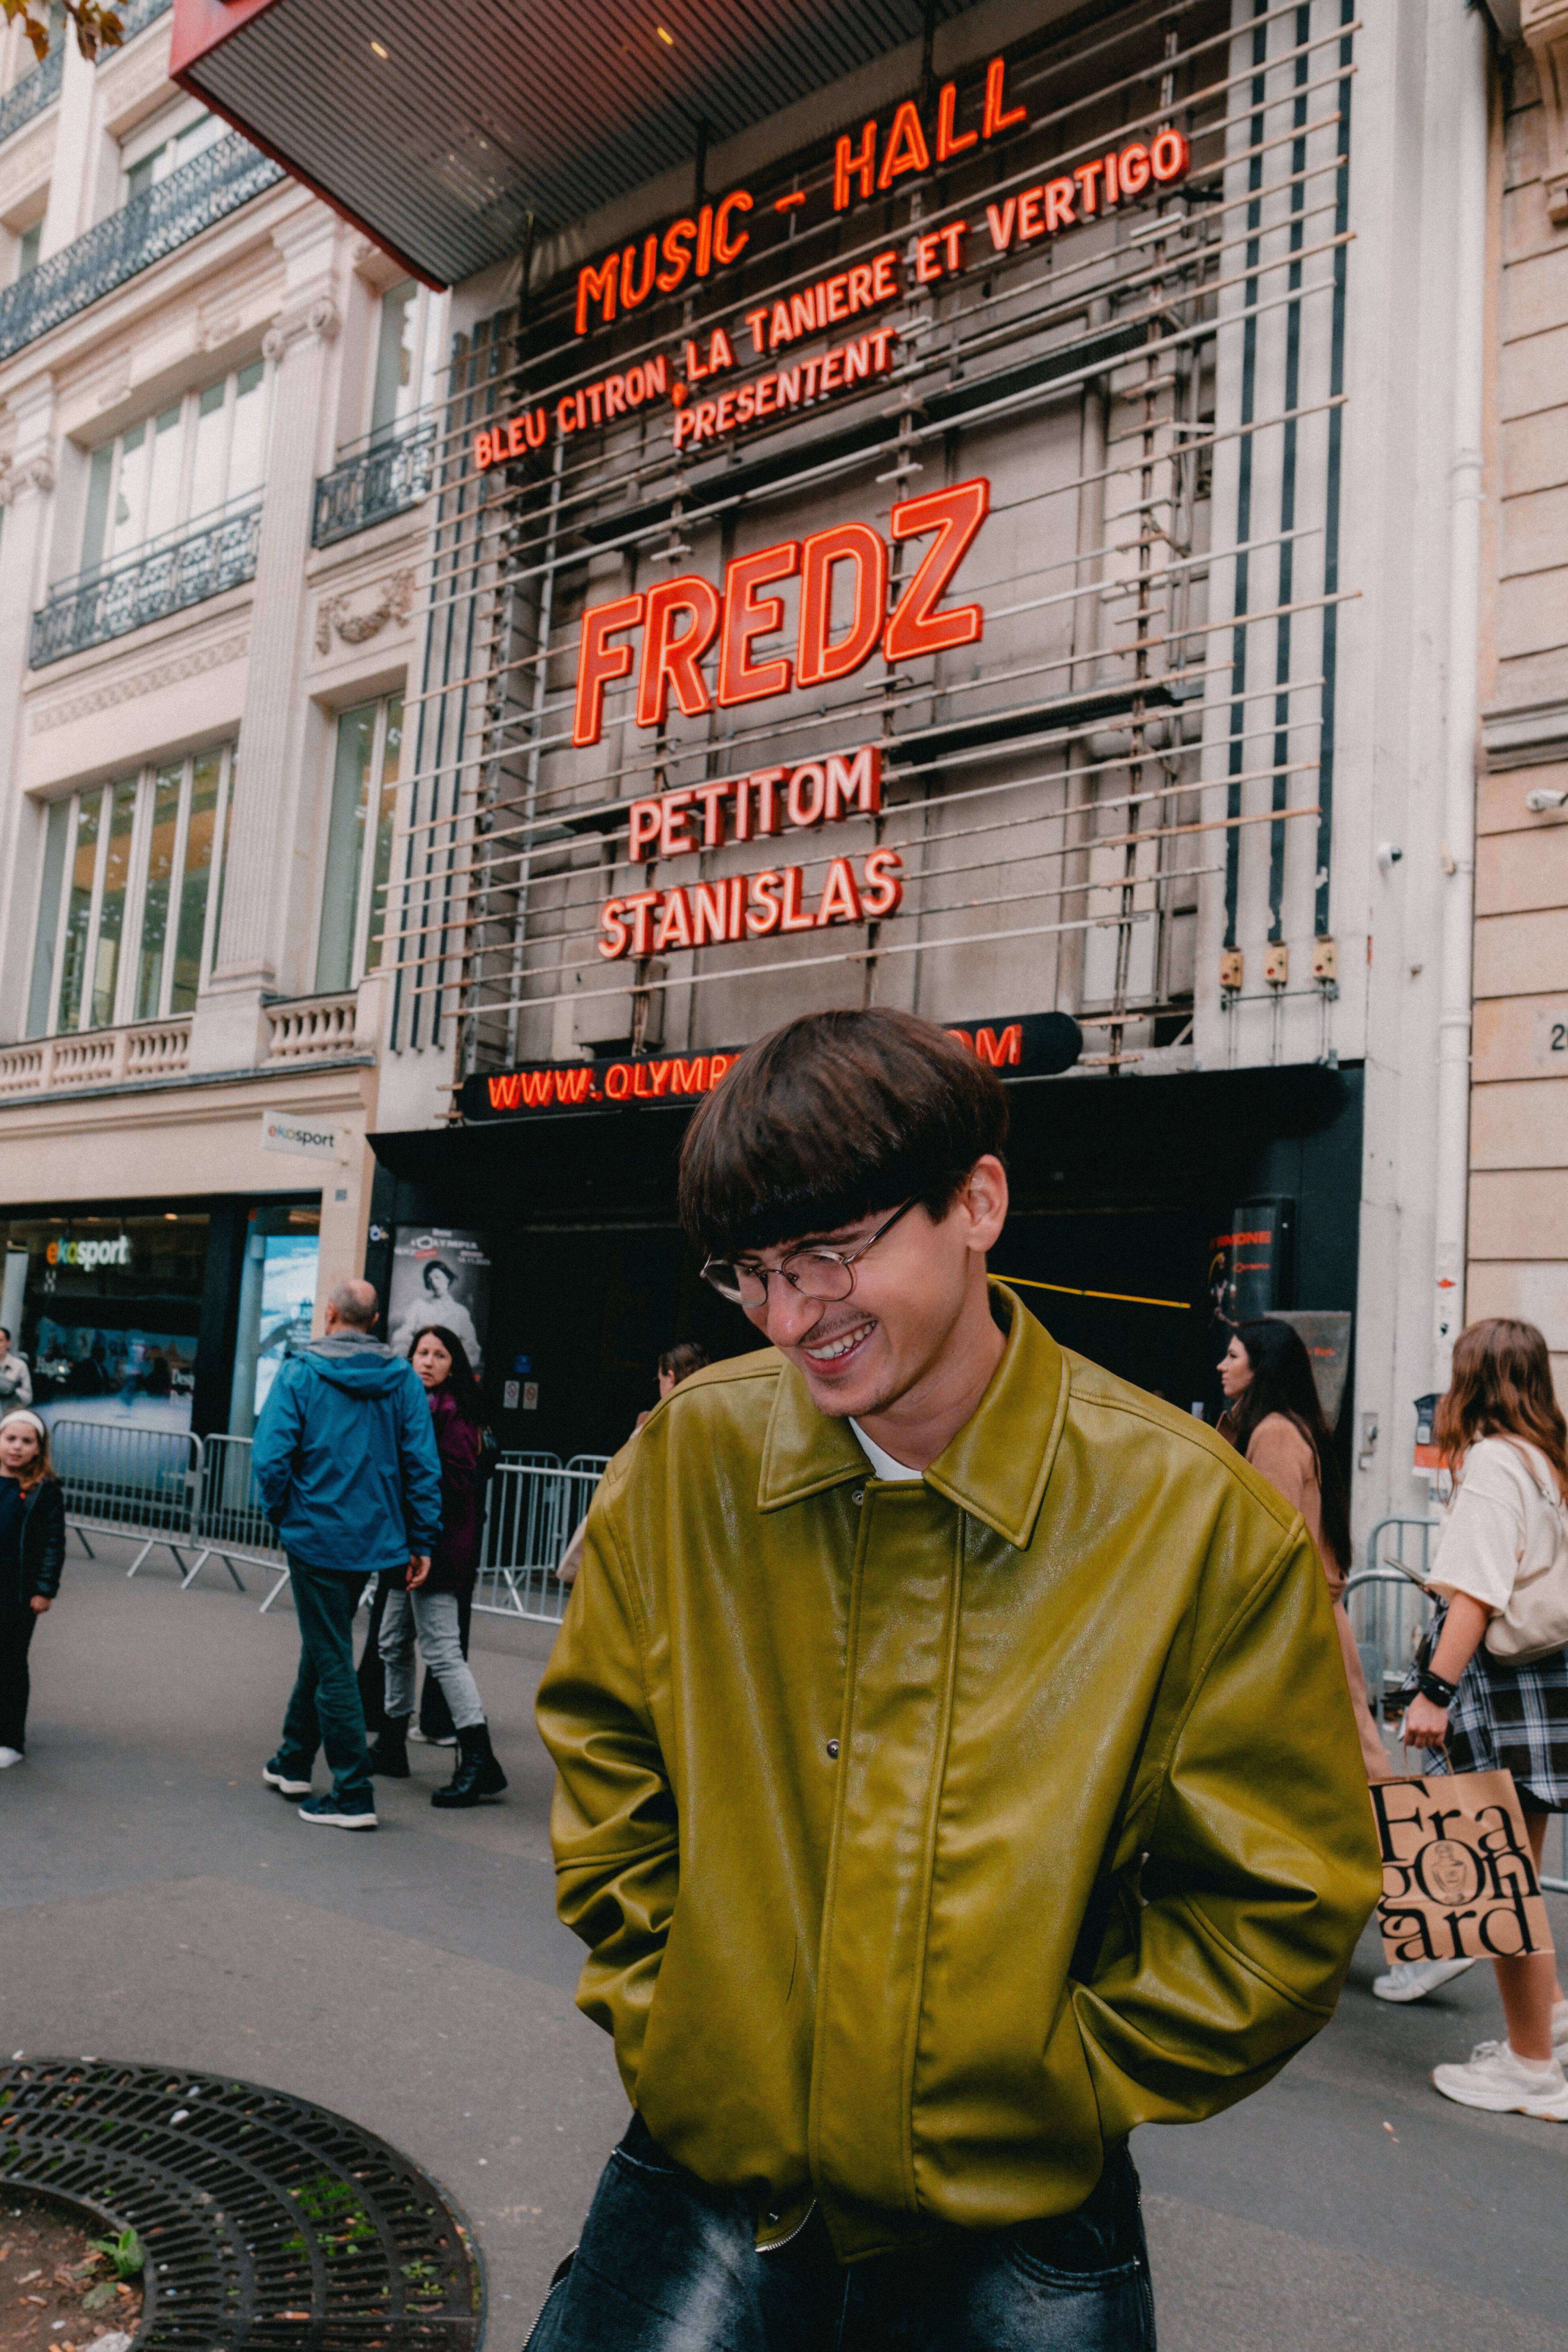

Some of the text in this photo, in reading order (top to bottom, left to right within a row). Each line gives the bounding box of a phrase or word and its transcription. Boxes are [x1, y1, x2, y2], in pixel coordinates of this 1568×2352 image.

[576, 190, 754, 335] MUSIC
[834, 56, 1027, 211] HALL
[473, 407, 547, 470] BLEU
[686, 328, 733, 381] LA
[746, 251, 898, 353] TANIERE
[917, 220, 967, 283] ET
[986, 129, 1187, 251] VERTIGO
[673, 327, 895, 449] PRESENTENT
[572, 476, 990, 747] FREDZ
[629, 744, 881, 864] PETITOM
[598, 848, 903, 960] STANISLAS
[268, 1124, 334, 1148] ekosport
[488, 1053, 741, 1110] WWW.OLYMP
[46, 1234, 129, 1272] ekosport
[1368, 1780, 1527, 1863] Fra
[1395, 1872, 1541, 1962] ard
